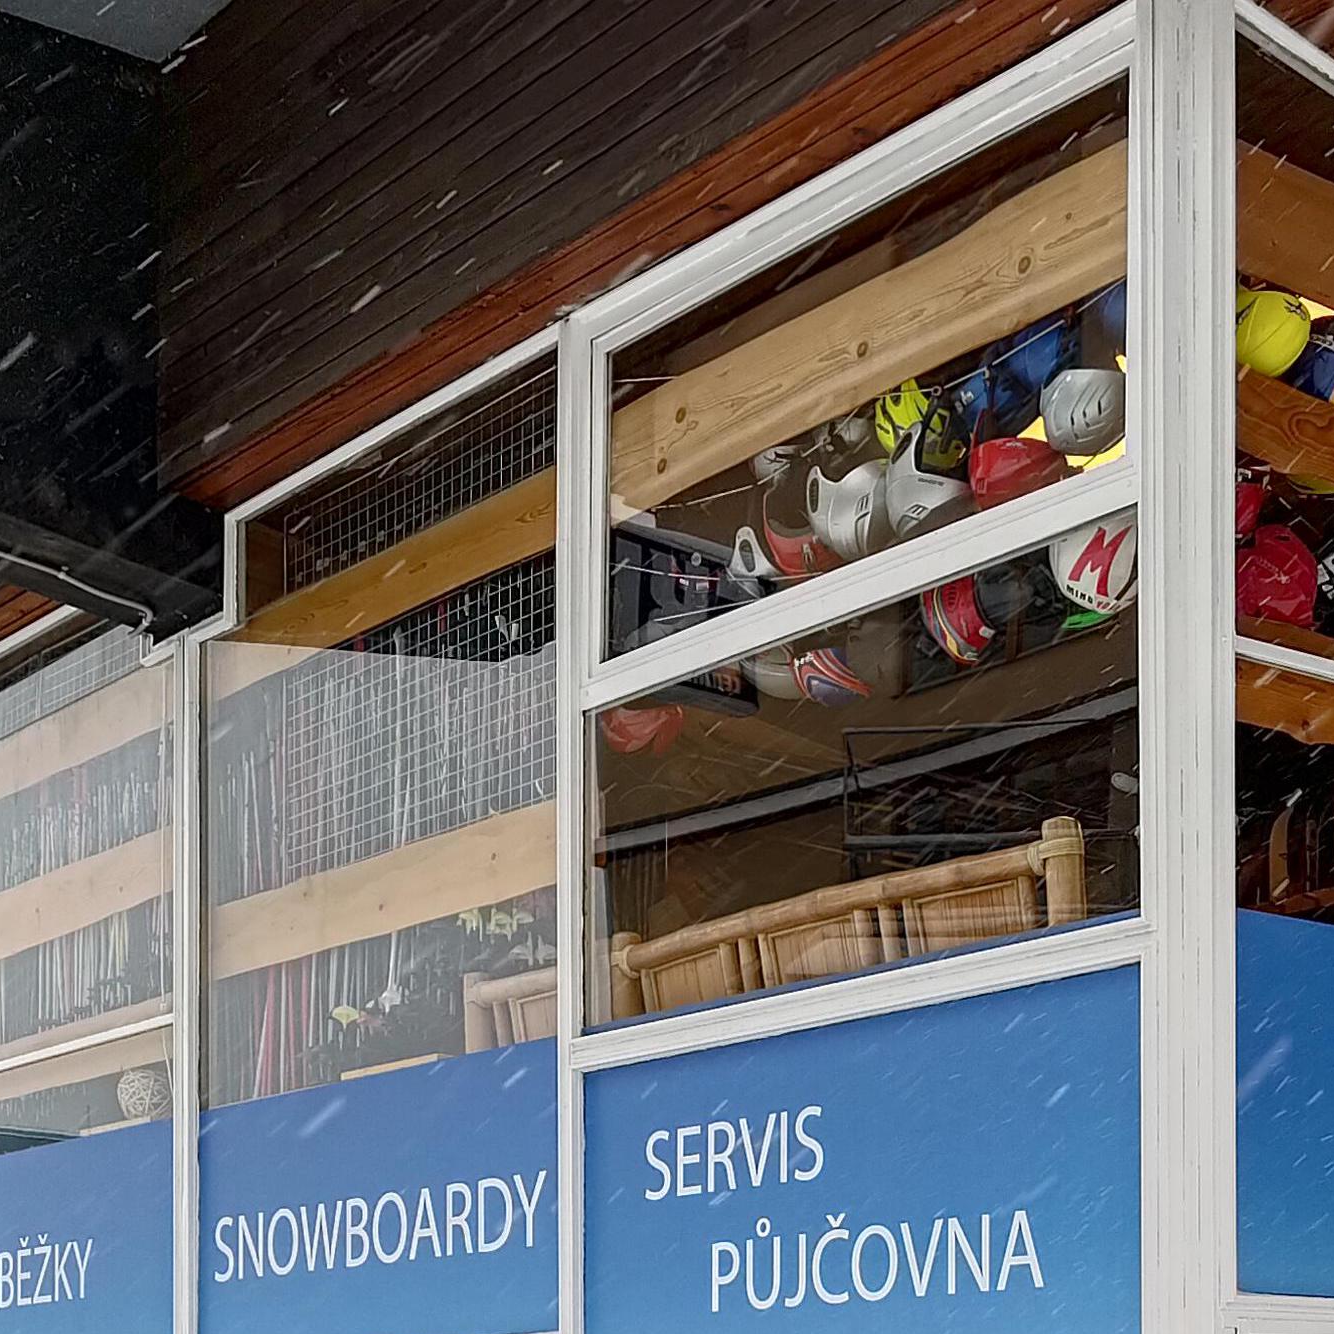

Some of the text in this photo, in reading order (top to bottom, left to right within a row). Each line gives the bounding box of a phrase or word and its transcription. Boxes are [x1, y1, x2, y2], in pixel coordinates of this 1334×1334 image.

[644, 1105, 825, 1201] SERVIS
[214, 1169, 547, 1283] SNOWBOARDY
[710, 1209, 1045, 1312] PŮJČOVNA
